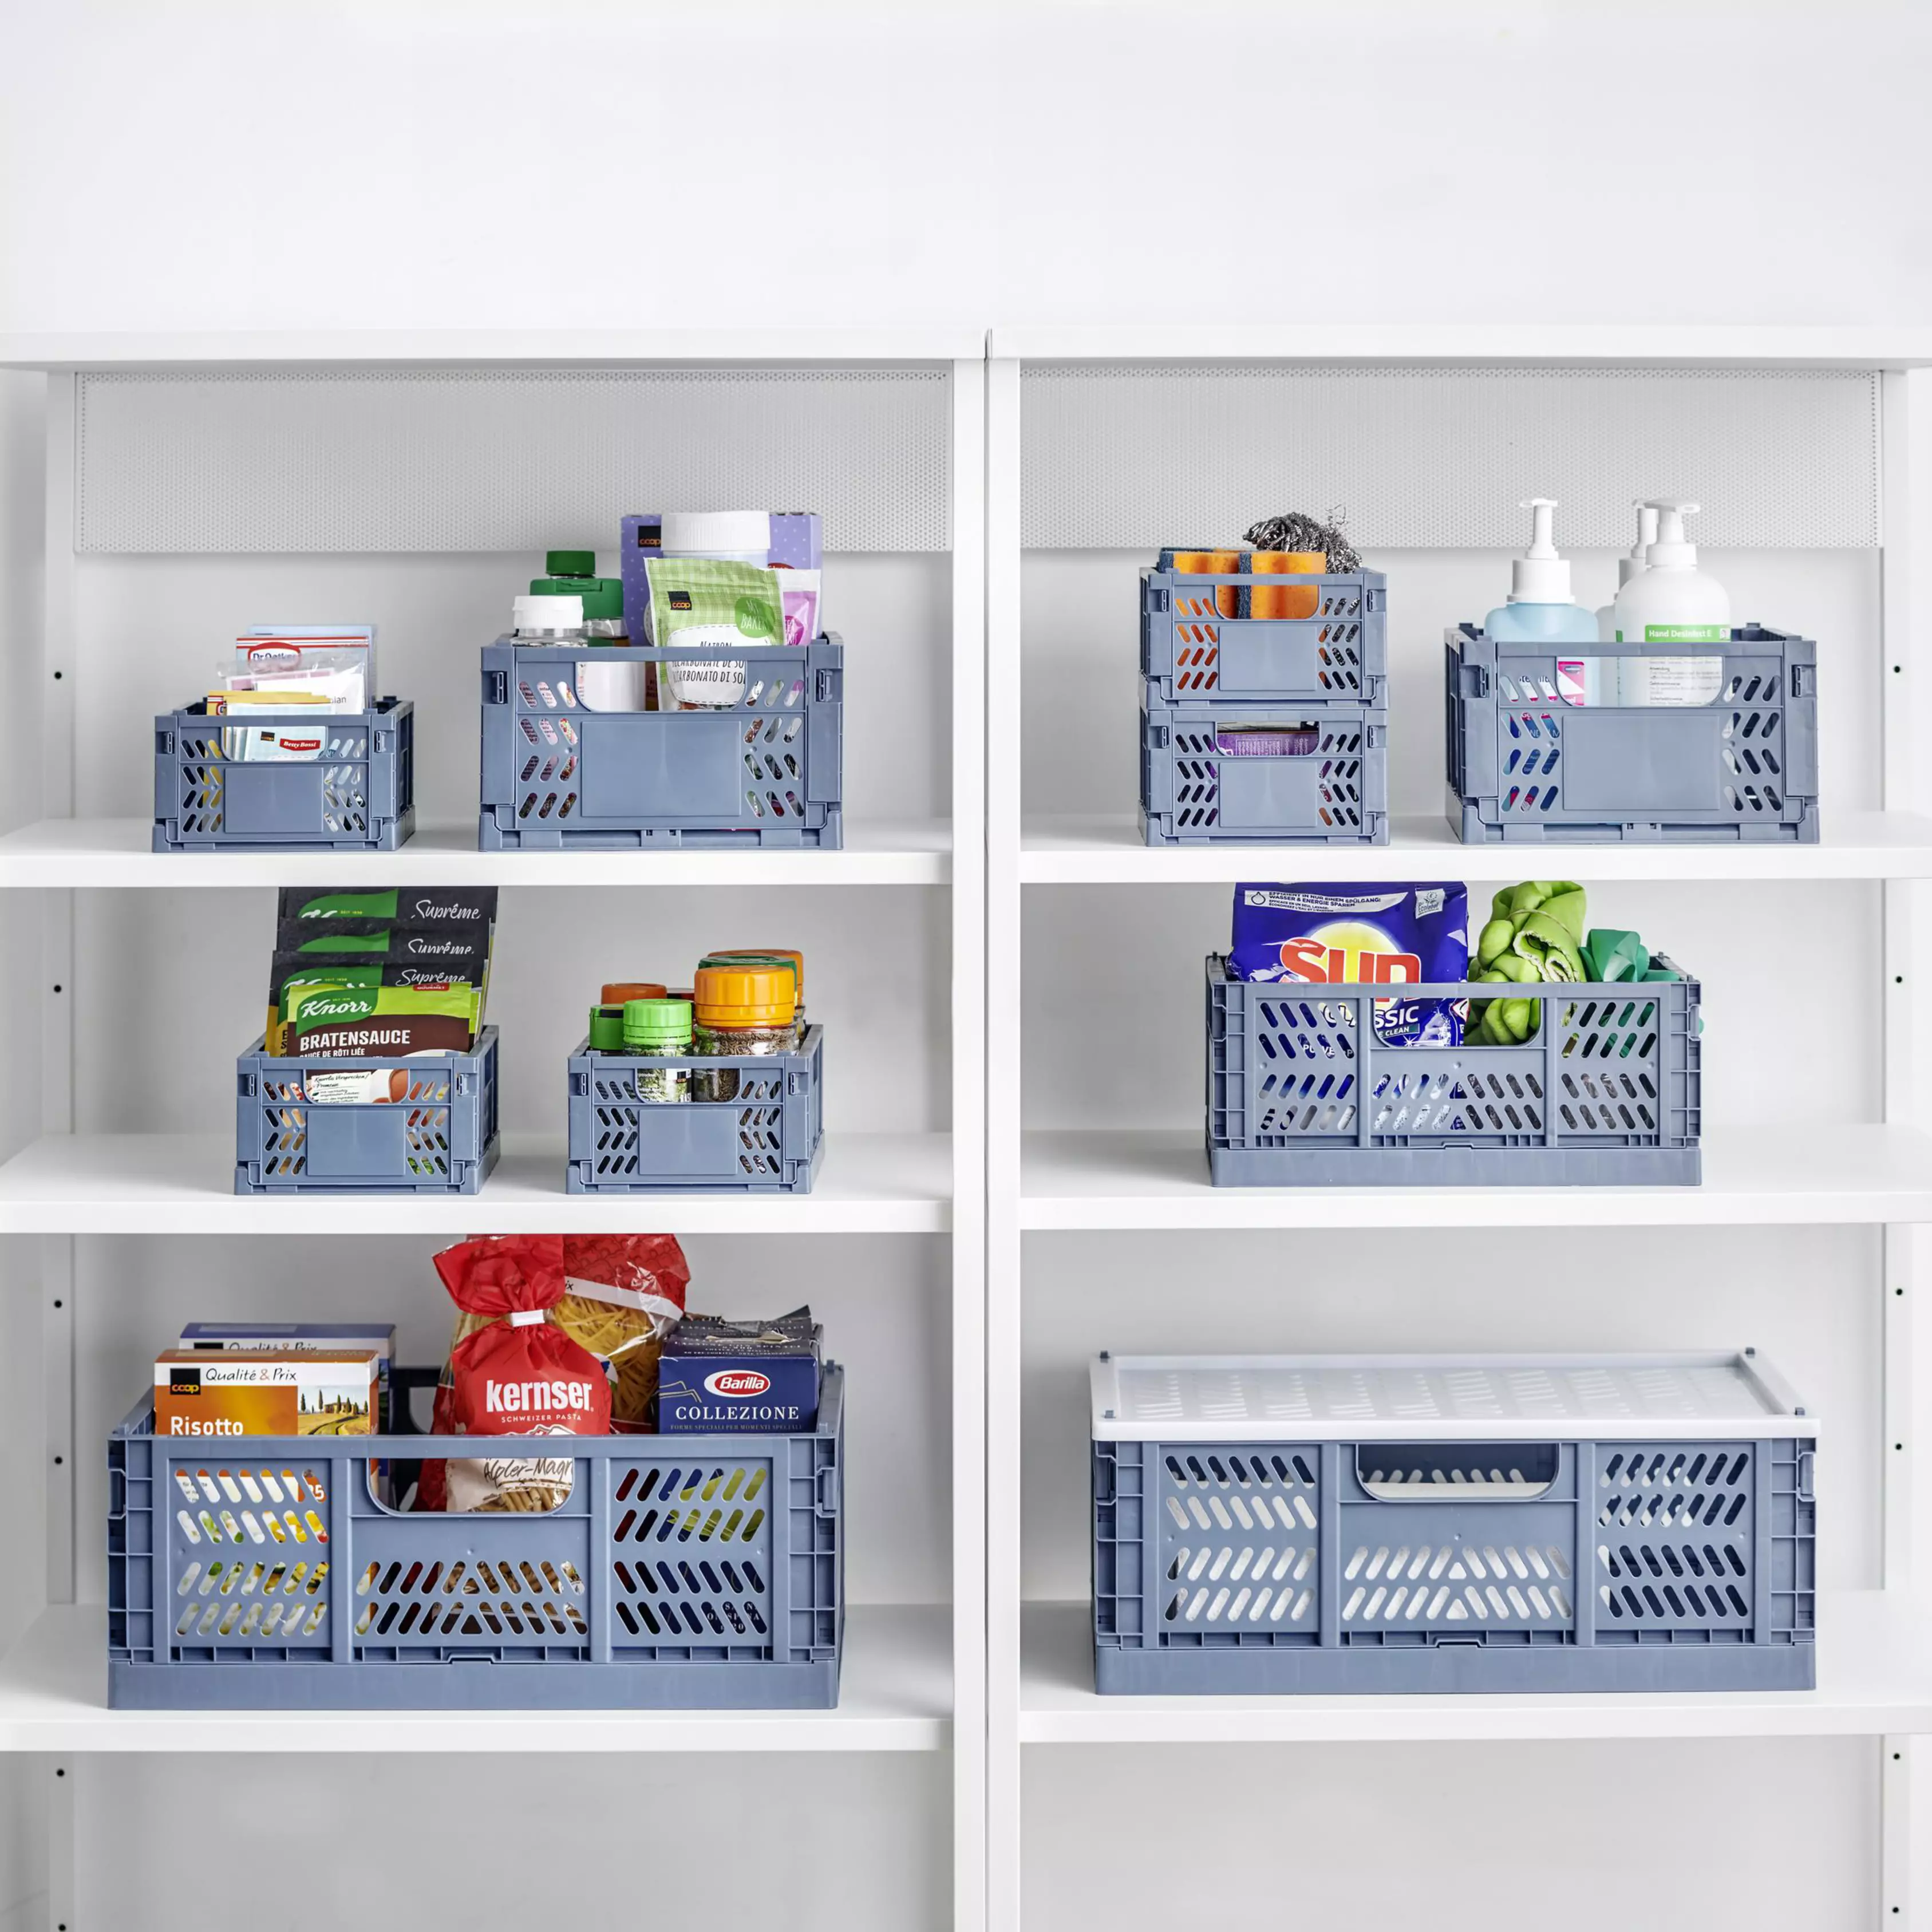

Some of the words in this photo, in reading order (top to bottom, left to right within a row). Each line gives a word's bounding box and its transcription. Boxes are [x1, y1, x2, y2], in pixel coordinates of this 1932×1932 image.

[720, 672, 730, 682] DI
[410, 900, 481, 919] Suprême
[395, 969, 465, 986] Suprême
[301, 999, 372, 1018] Knorr
[1385, 1026, 1409, 1037] CLEAN
[300, 1030, 410, 1052] BRATENSAUCE
[333, 1049, 349, 1057] RÔTI
[351, 1047, 365, 1055] LIÉE
[206, 1368, 256, 1381] Qualité
[259, 1370, 270, 1381] &
[272, 1368, 297, 1381] Prix
[172, 1384, 199, 1394] coop
[720, 1376, 765, 1389] Barilla
[487, 1380, 592, 1413] kernser
[501, 1415, 552, 1423] SCHWEIZER
[675, 1406, 799, 1420] COLLEZIONE
[171, 1416, 244, 1436] Risotto
[484, 1458, 573, 1489] Älpler-Magr
